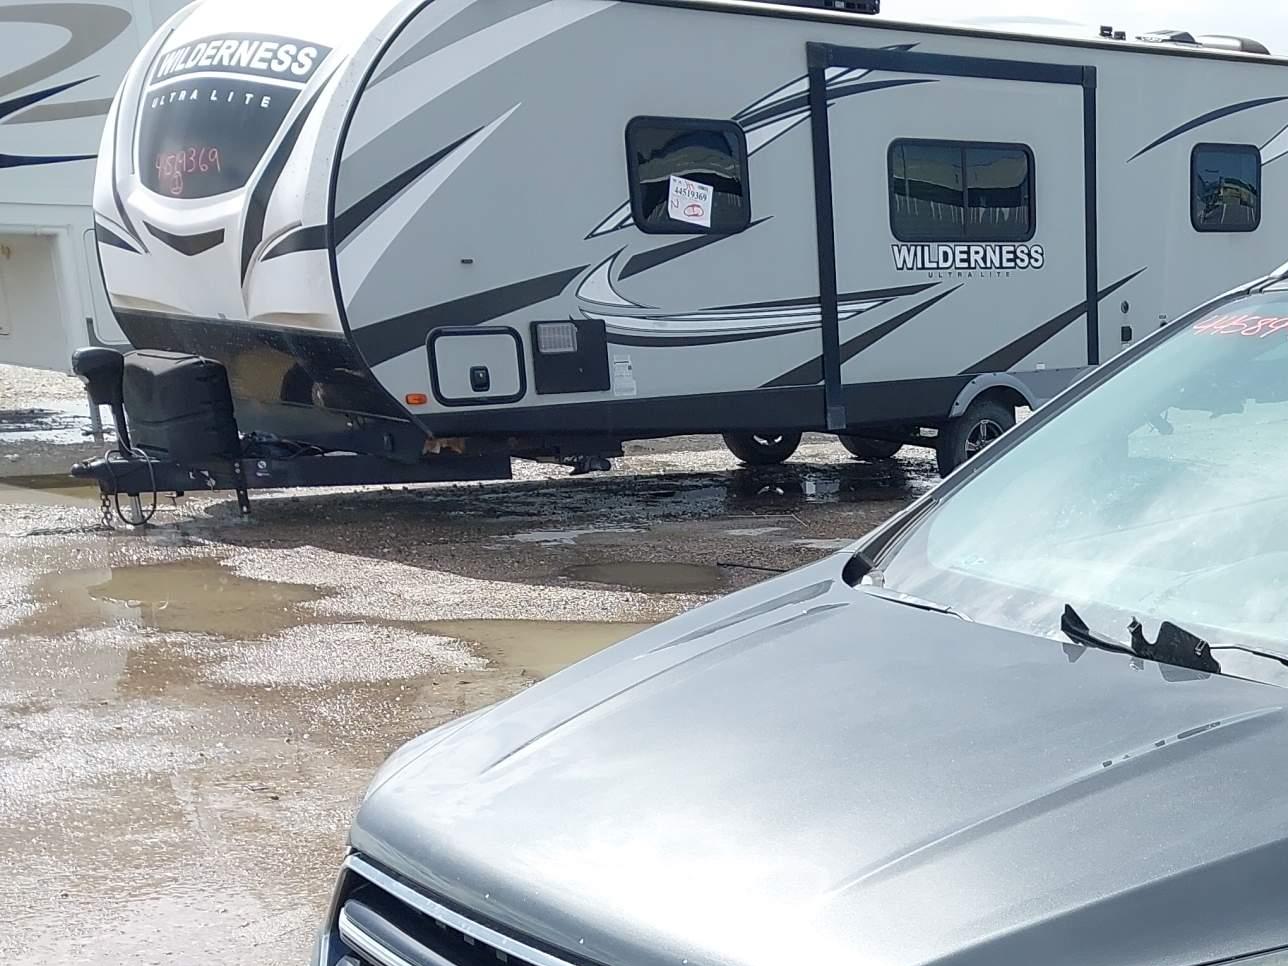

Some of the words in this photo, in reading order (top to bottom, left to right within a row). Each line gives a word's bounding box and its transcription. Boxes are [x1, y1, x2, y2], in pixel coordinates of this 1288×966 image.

[157, 39, 318, 78] WILDERNESS
[151, 89, 198, 108] ULTRA
[210, 90, 272, 108] LITE
[674, 186, 707, 201] 44519369
[891, 244, 1044, 270] WILDERNESS
